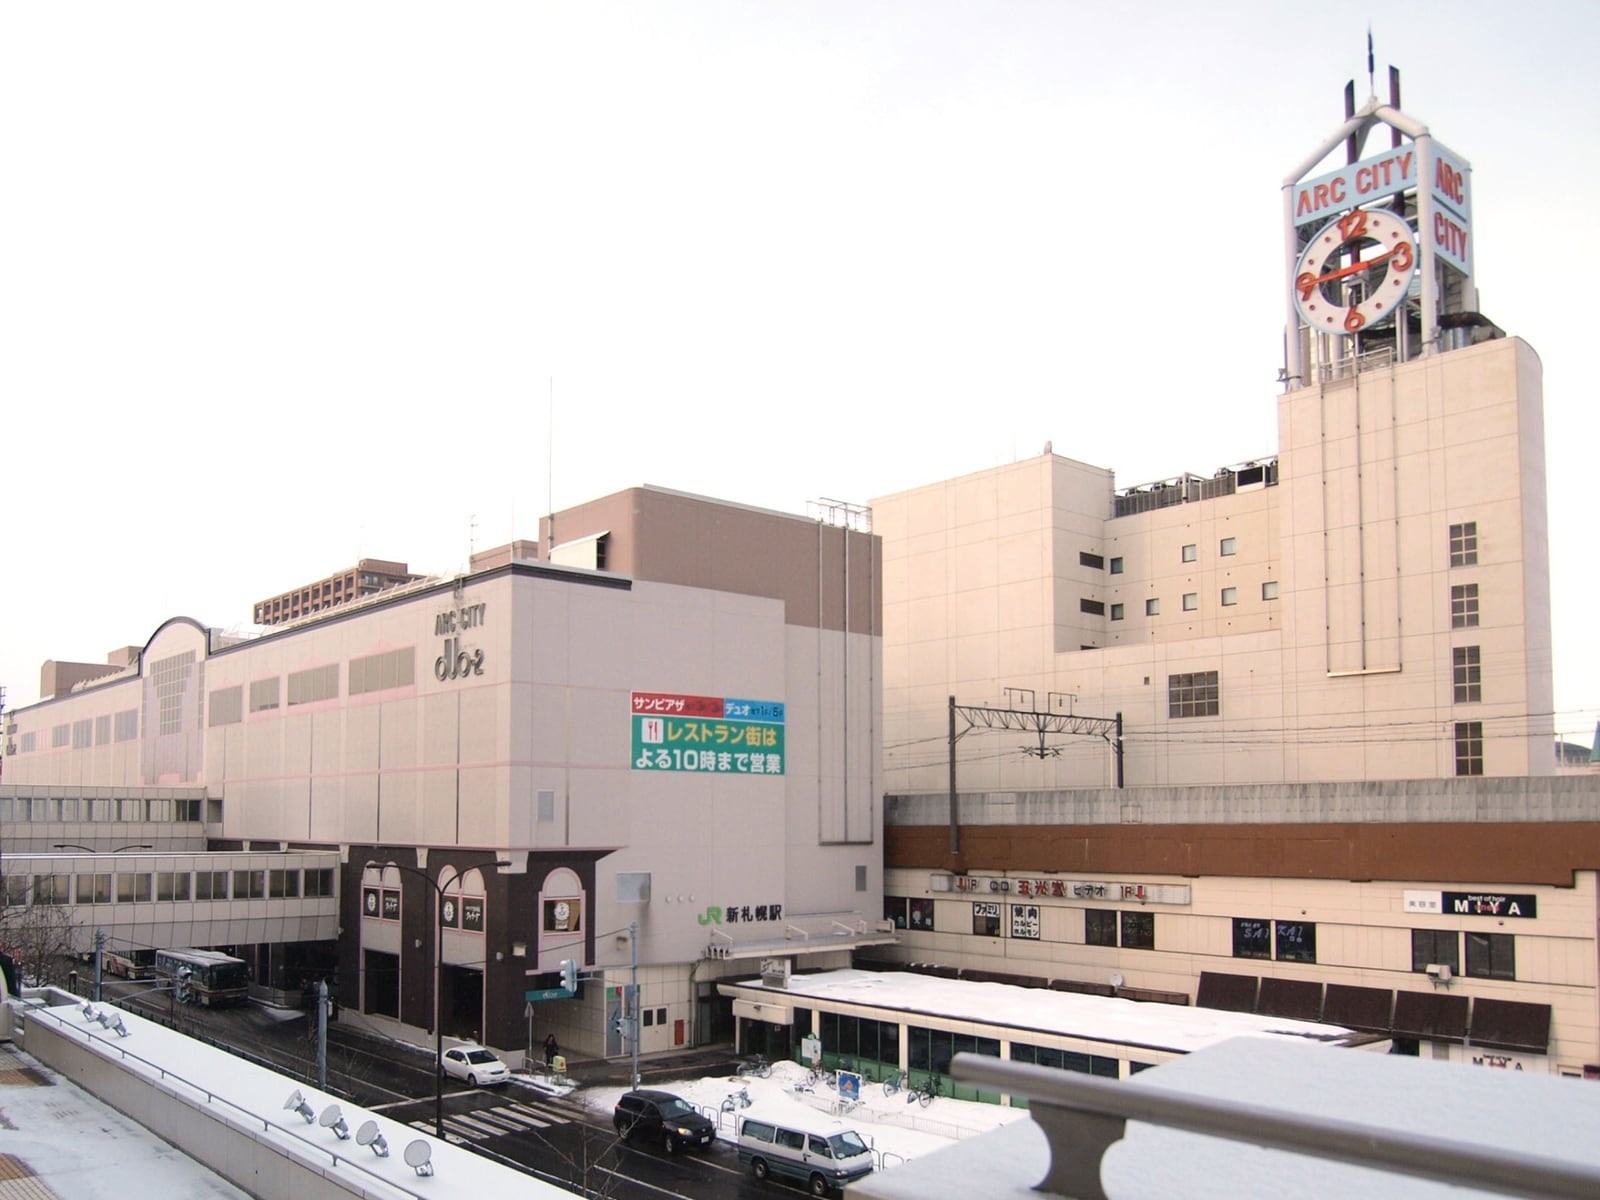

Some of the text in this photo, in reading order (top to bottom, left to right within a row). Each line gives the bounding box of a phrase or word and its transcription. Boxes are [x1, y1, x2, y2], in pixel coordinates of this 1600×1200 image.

[1297, 152, 1412, 217] ARC CITY
[1436, 157, 1464, 205] ARC
[1337, 208, 1368, 241] 12
[1434, 212, 1467, 262] CITY
[1392, 241, 1413, 272] 3
[1296, 272, 1317, 301] 9
[1344, 305, 1366, 332] 6
[460, 602, 486, 630] CITY
[725, 703, 750, 716] デュオ
[667, 721, 777, 746] レストラン街は
[636, 748, 781, 773] よる10時まで営業
[697, 904, 782, 926] JR 新札幌駅
[1454, 899, 1521, 916] MIYA
